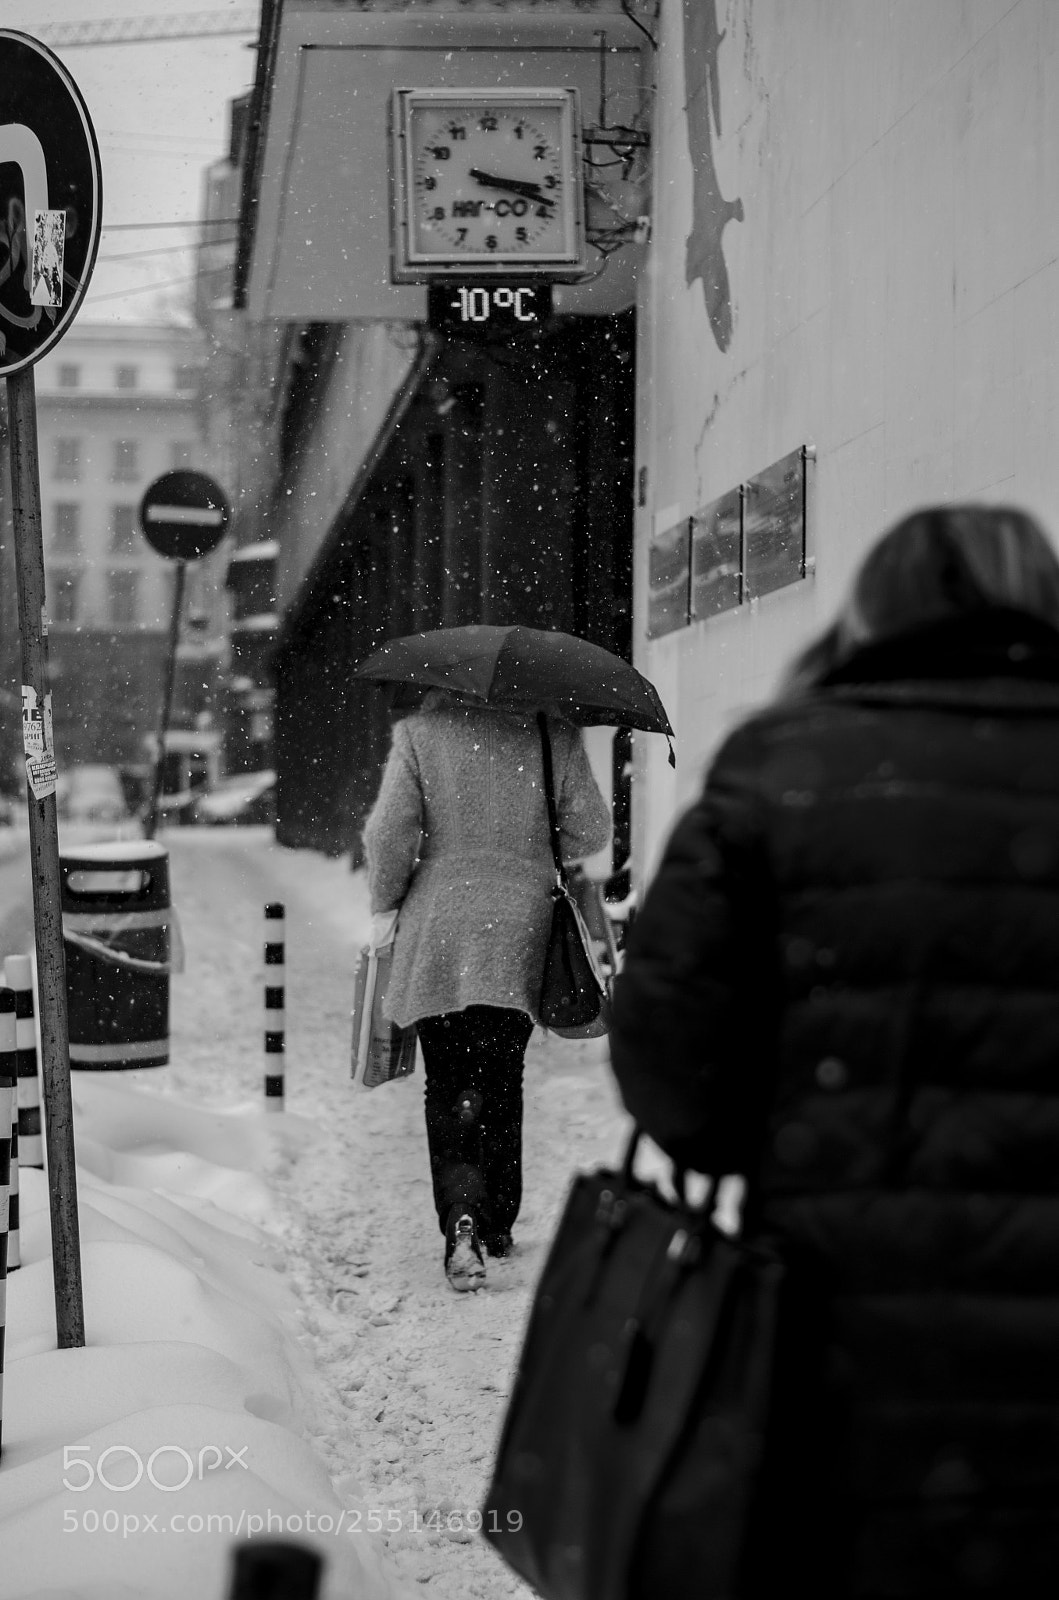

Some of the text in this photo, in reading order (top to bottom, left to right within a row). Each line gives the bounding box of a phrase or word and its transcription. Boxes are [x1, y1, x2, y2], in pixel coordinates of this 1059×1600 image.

[449, 126, 466, 140] 11
[514, 126, 524, 140] 1
[533, 145, 546, 160] 2
[424, 176, 437, 190] 9
[544, 175, 556, 189] 3
[434, 206, 446, 221] 8
[535, 205, 548, 219] 4
[457, 228, 469, 242] 7
[516, 227, 528, 241] 5
[485, 235, 497, 250] 6
